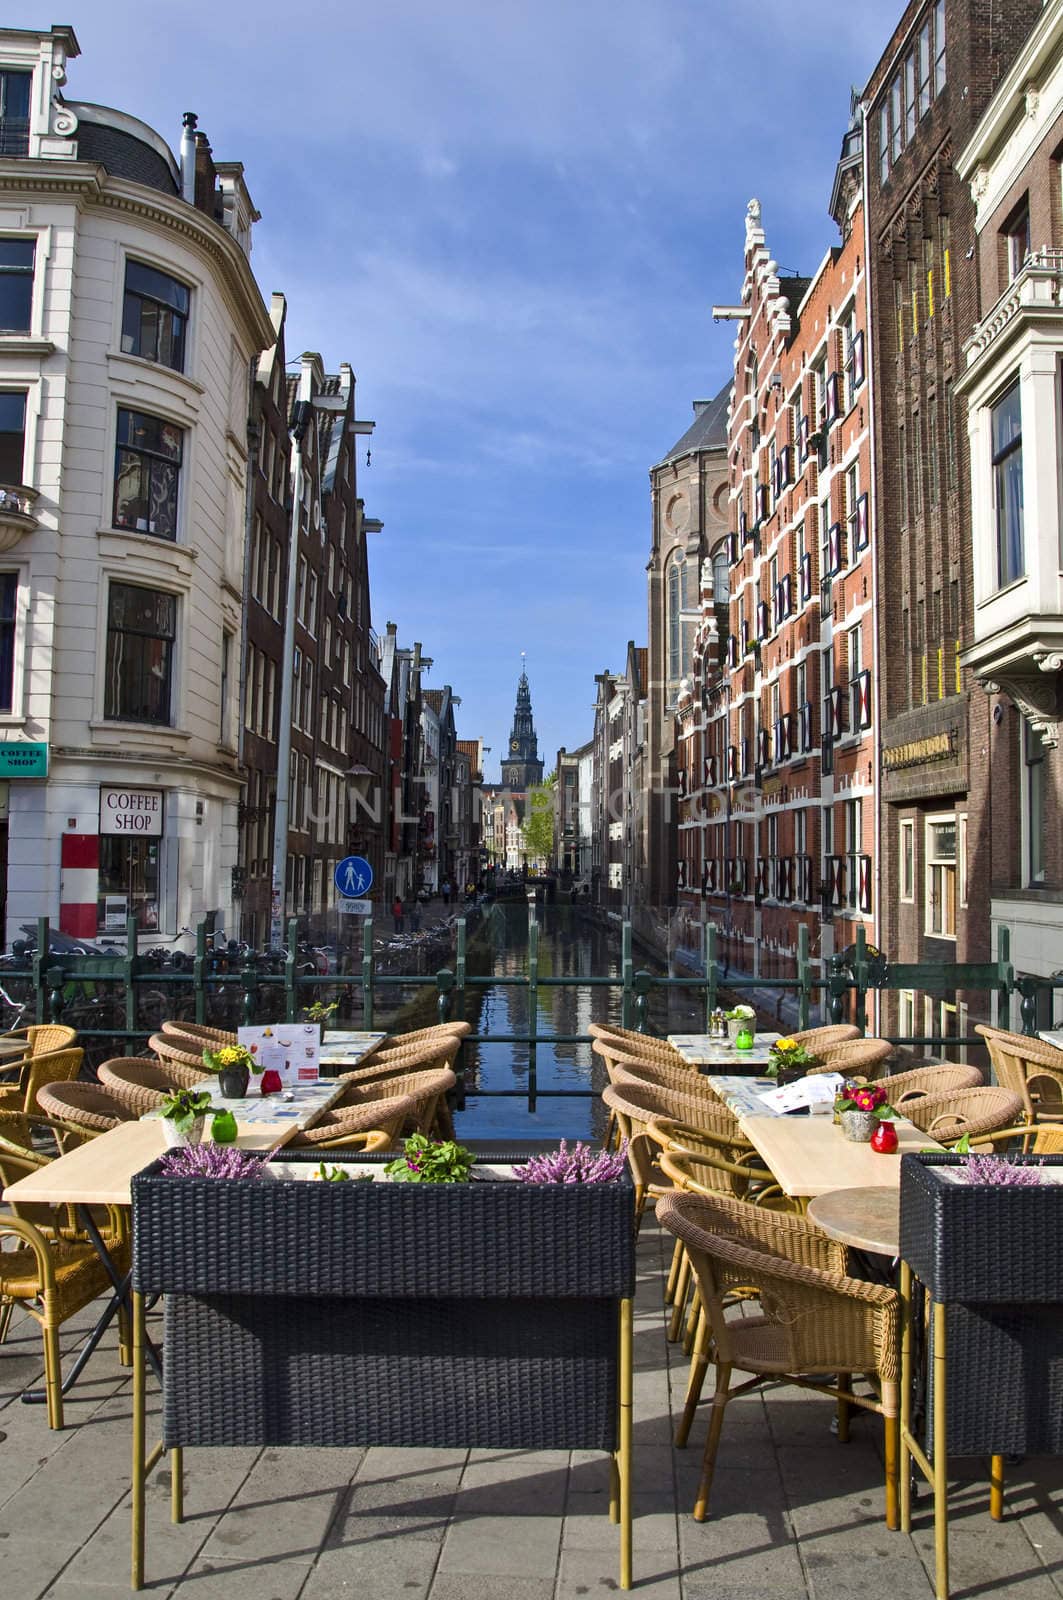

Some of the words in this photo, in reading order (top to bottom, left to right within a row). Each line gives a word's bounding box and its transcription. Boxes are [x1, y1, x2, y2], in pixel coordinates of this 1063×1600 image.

[0, 749, 43, 757] COFFEE
[8, 759, 38, 767] SHOP
[107, 793, 159, 811] COFFEE
[115, 813, 152, 830] SHOP
